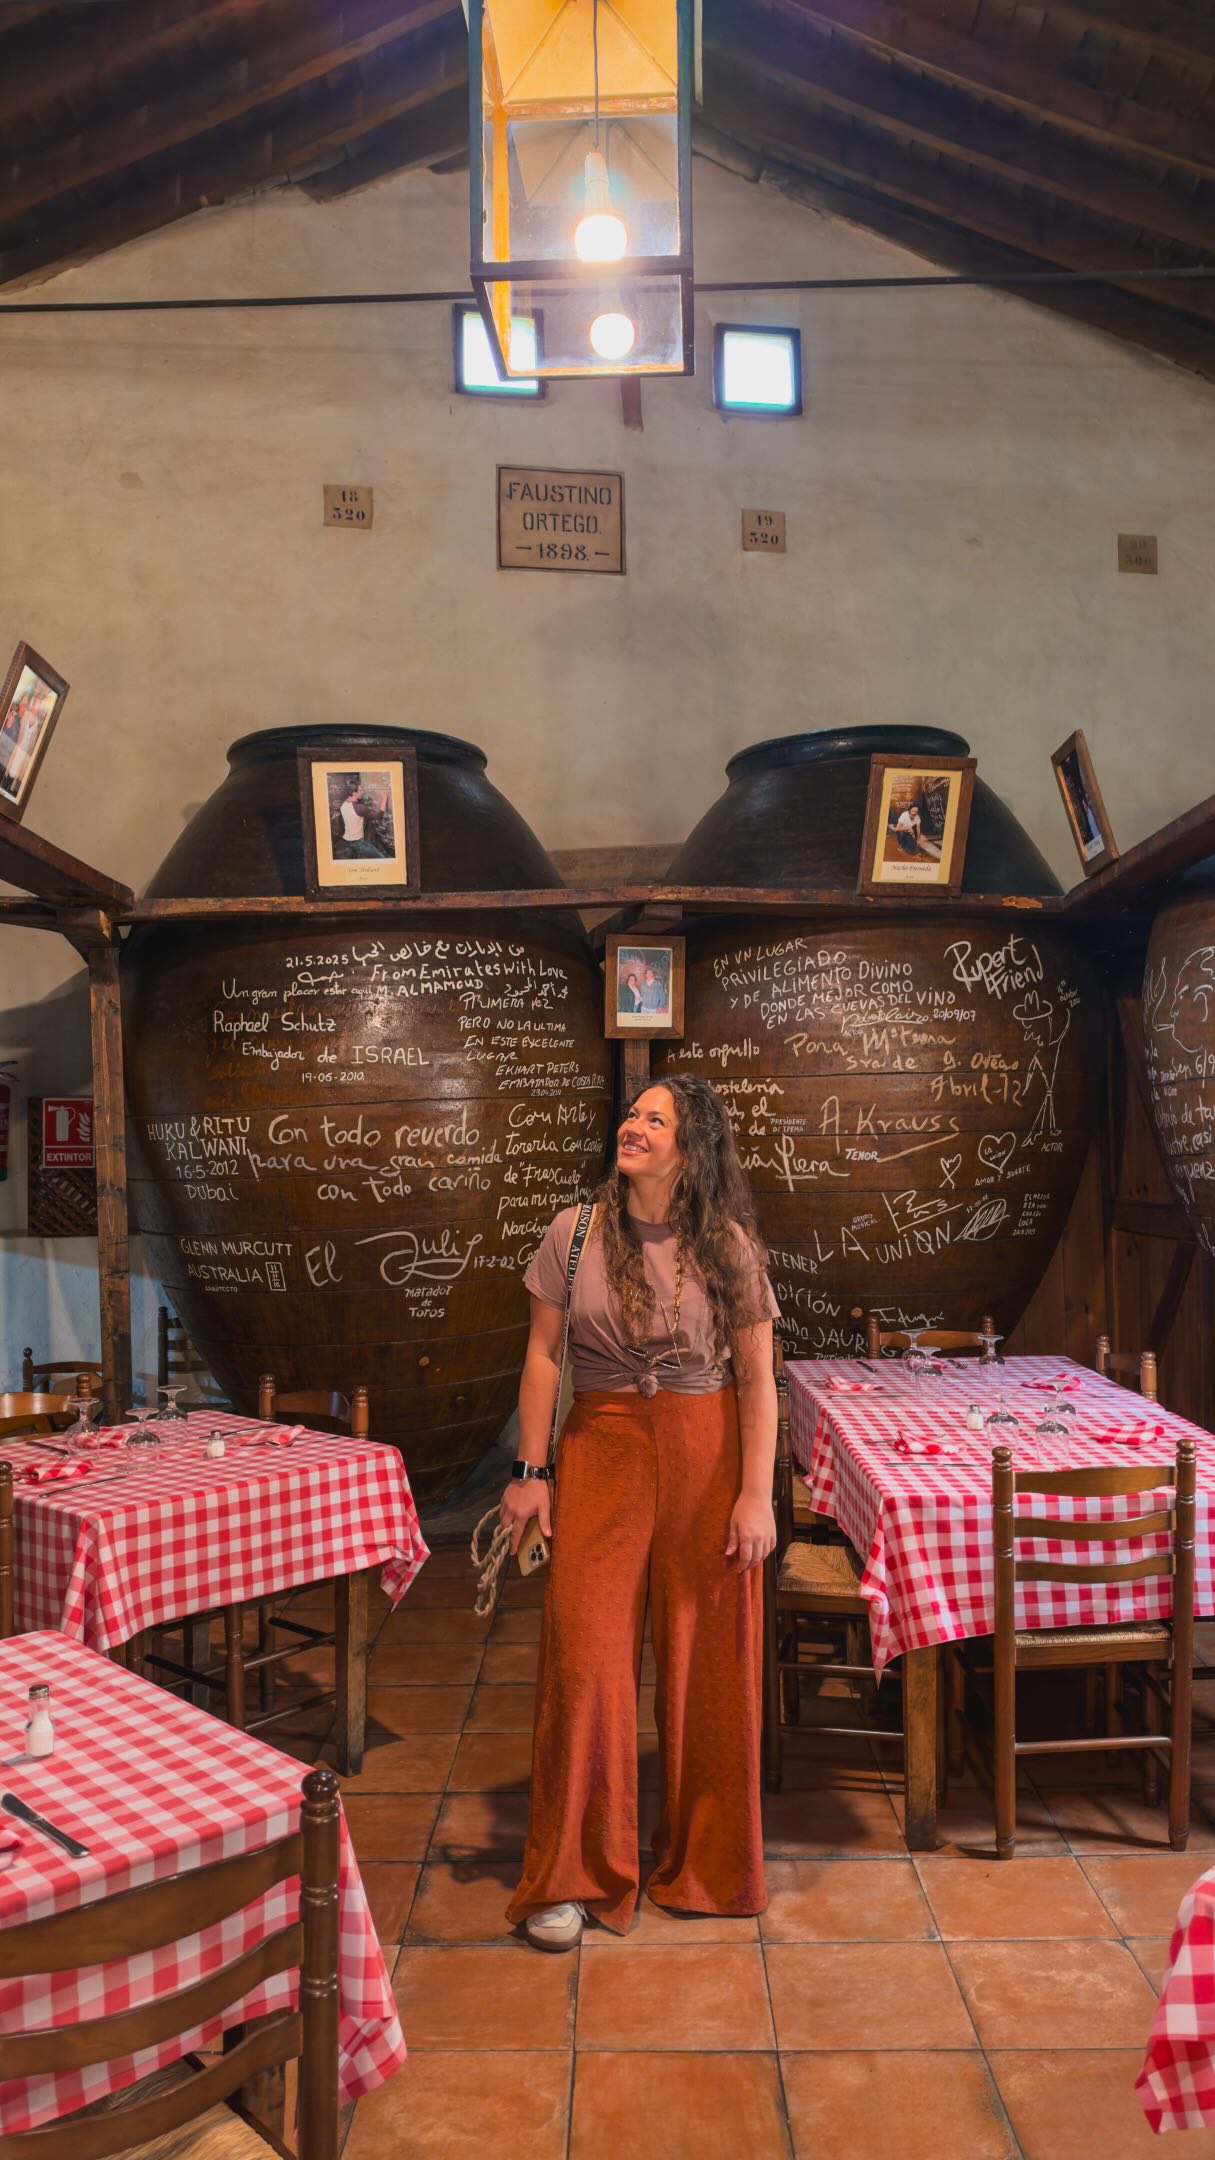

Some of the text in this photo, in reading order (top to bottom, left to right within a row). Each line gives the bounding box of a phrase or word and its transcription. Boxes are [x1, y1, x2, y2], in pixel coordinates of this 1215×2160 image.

[507, 481, 612, 506] FAUSTINO
[755, 937, 809, 961] LUGAR
[285, 954, 350, 968] 21.5.2025
[419, 959, 502, 980] Emirates
[251, 988, 278, 1005] gran
[283, 981, 320, 1003] placer
[743, 990, 761, 1009] DE
[771, 966, 852, 1000] ALIMENTO
[760, 992, 806, 1021] DONDE
[766, 1013, 788, 1030] EN
[795, 1006, 827, 1022] LAS
[830, 994, 886, 1015] CUEVAS
[886, 992, 912, 1006] DEL
[213, 1009, 269, 1041] Raphael
[281, 1011, 337, 1032] Schutz
[457, 1015, 491, 1032] PERO
[496, 1018, 515, 1030] NO
[517, 1019, 531, 1031] LA
[463, 1035, 484, 1049] EN
[491, 1036, 518, 1047] ESTE
[678, 1041, 704, 1060] este
[242, 1042, 305, 1071] Embajador
[316, 1045, 338, 1064] de
[351, 1045, 431, 1066] ISRAEL
[892, 1053, 919, 1072] de
[751, 1096, 777, 1118] el
[189, 1115, 201, 1142] &
[202, 1115, 251, 1136] RITU
[268, 1114, 309, 1145] Con
[320, 1114, 382, 1148] todo
[46, 1152, 93, 1162] EXTINTOR
[503, 1165, 519, 1185] de
[317, 1183, 359, 1202] con
[361, 1174, 412, 1204] todo
[180, 1238, 294, 1256] GLENN MURCUTT
[813, 1226, 871, 1263] LA
[187, 1263, 265, 1284] AUSTRALIA
[305, 1239, 344, 1288] El
[408, 1307, 446, 1319] Toros
[421, 1298, 433, 1307] de
